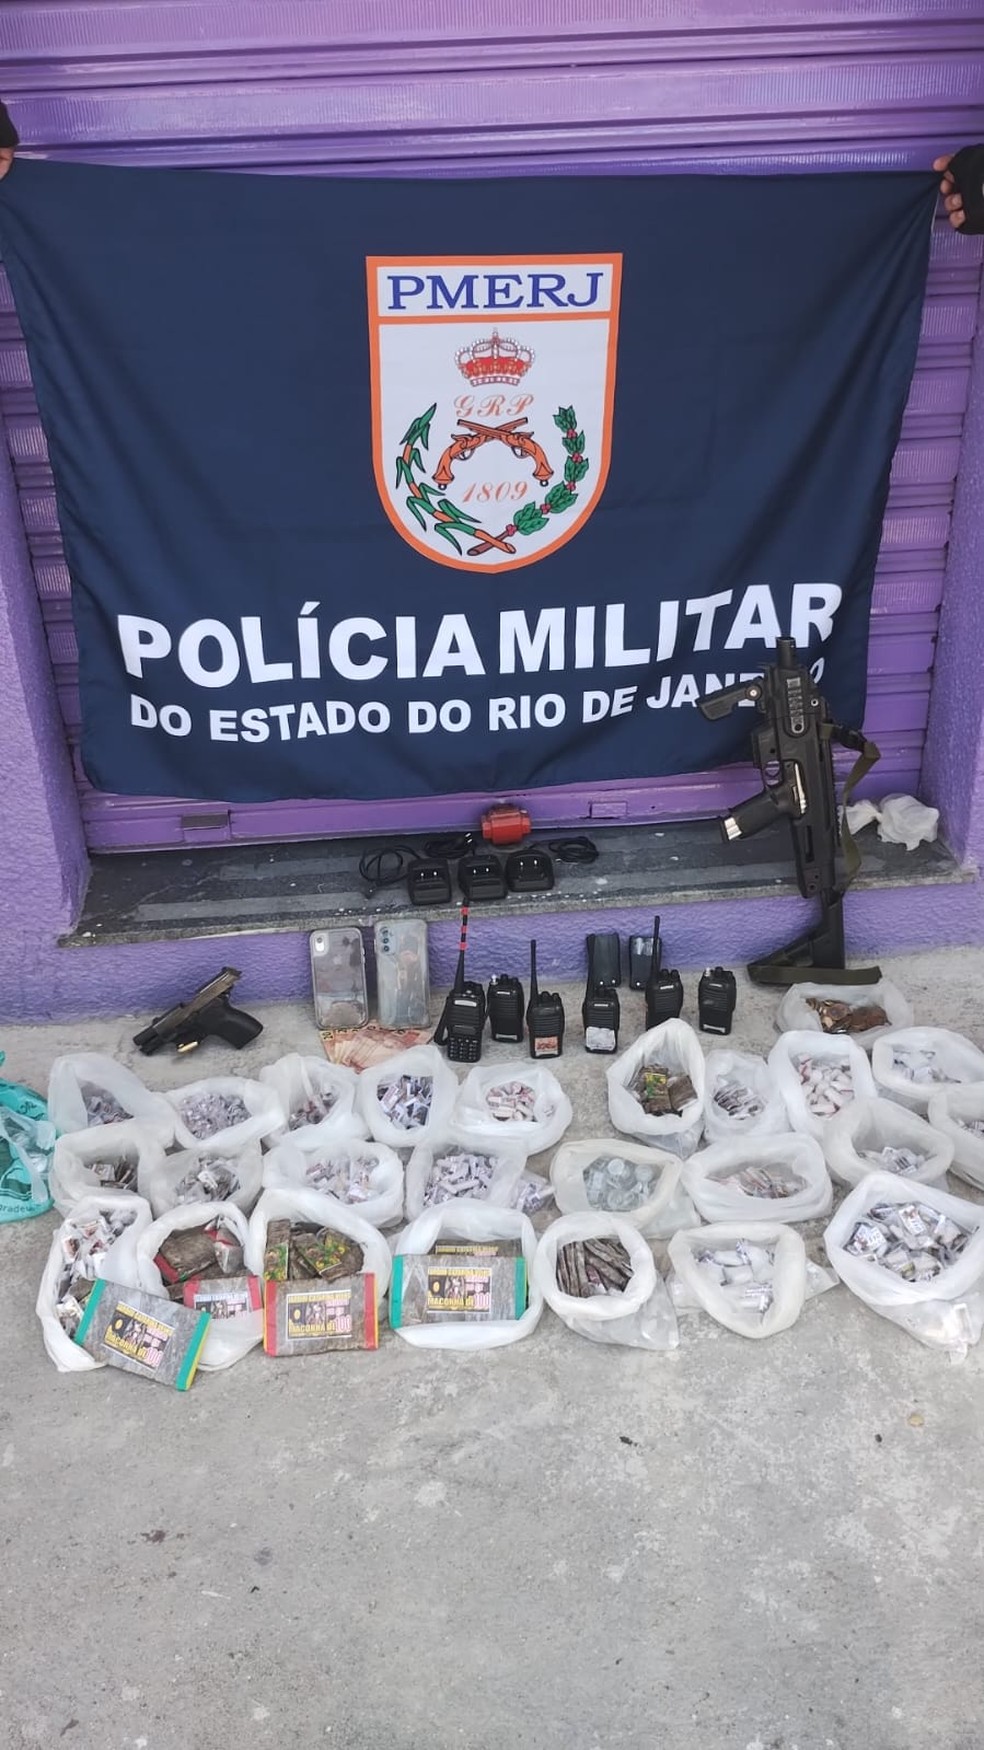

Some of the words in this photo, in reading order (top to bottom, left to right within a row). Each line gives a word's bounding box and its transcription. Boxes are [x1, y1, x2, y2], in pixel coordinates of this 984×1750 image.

[387, 272, 604, 310] PMERJ
[453, 394, 535, 418] GRP
[462, 481, 528, 503] 1809
[117, 601, 486, 688] POLÍCIA
[499, 583, 842, 674] MILITAR
[130, 694, 192, 737] DO
[210, 701, 391, 743] ESTADO
[408, 699, 471, 734] DO
[488, 693, 566, 731] RIO
[582, 685, 638, 724] DE
